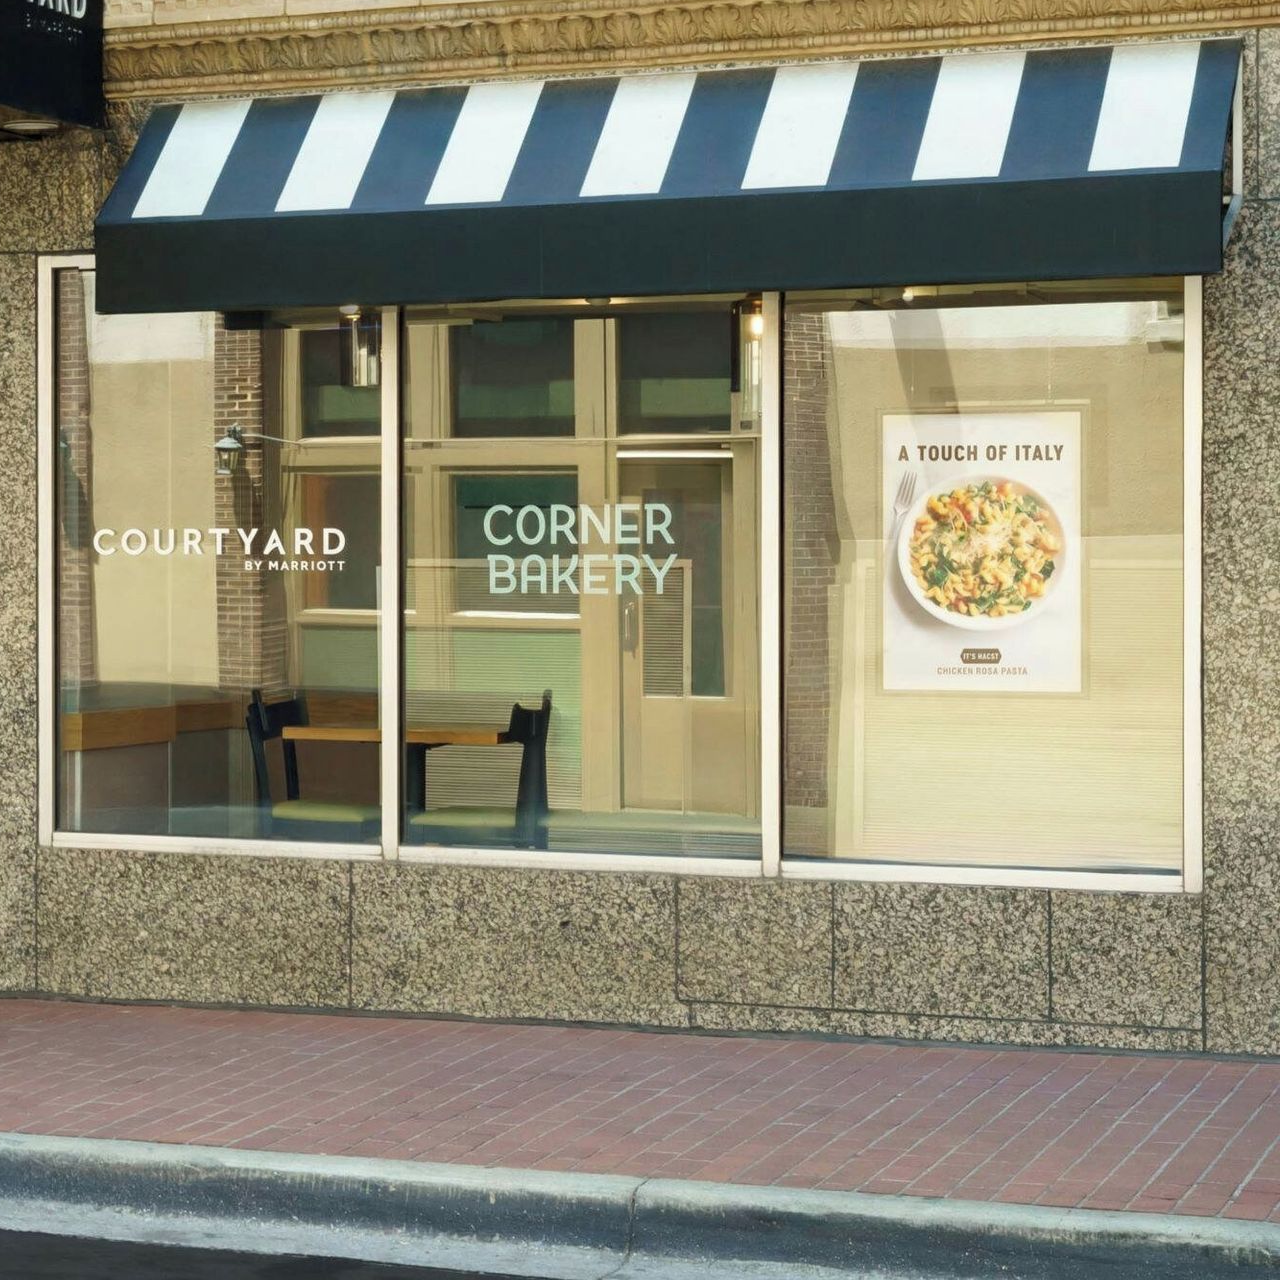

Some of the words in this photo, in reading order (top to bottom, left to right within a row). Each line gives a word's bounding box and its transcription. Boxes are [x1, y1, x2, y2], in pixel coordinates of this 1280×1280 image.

[898, 445, 909, 462] A
[917, 445, 978, 462] TOUCH
[986, 444, 1008, 461] OF
[1015, 444, 1064, 461] ITALY
[483, 503, 676, 546] CORNER
[93, 528, 347, 556] COURTYARD
[244, 560, 263, 571] BY
[268, 560, 346, 571] MARRIOTT
[487, 553, 678, 595] BAKERY
